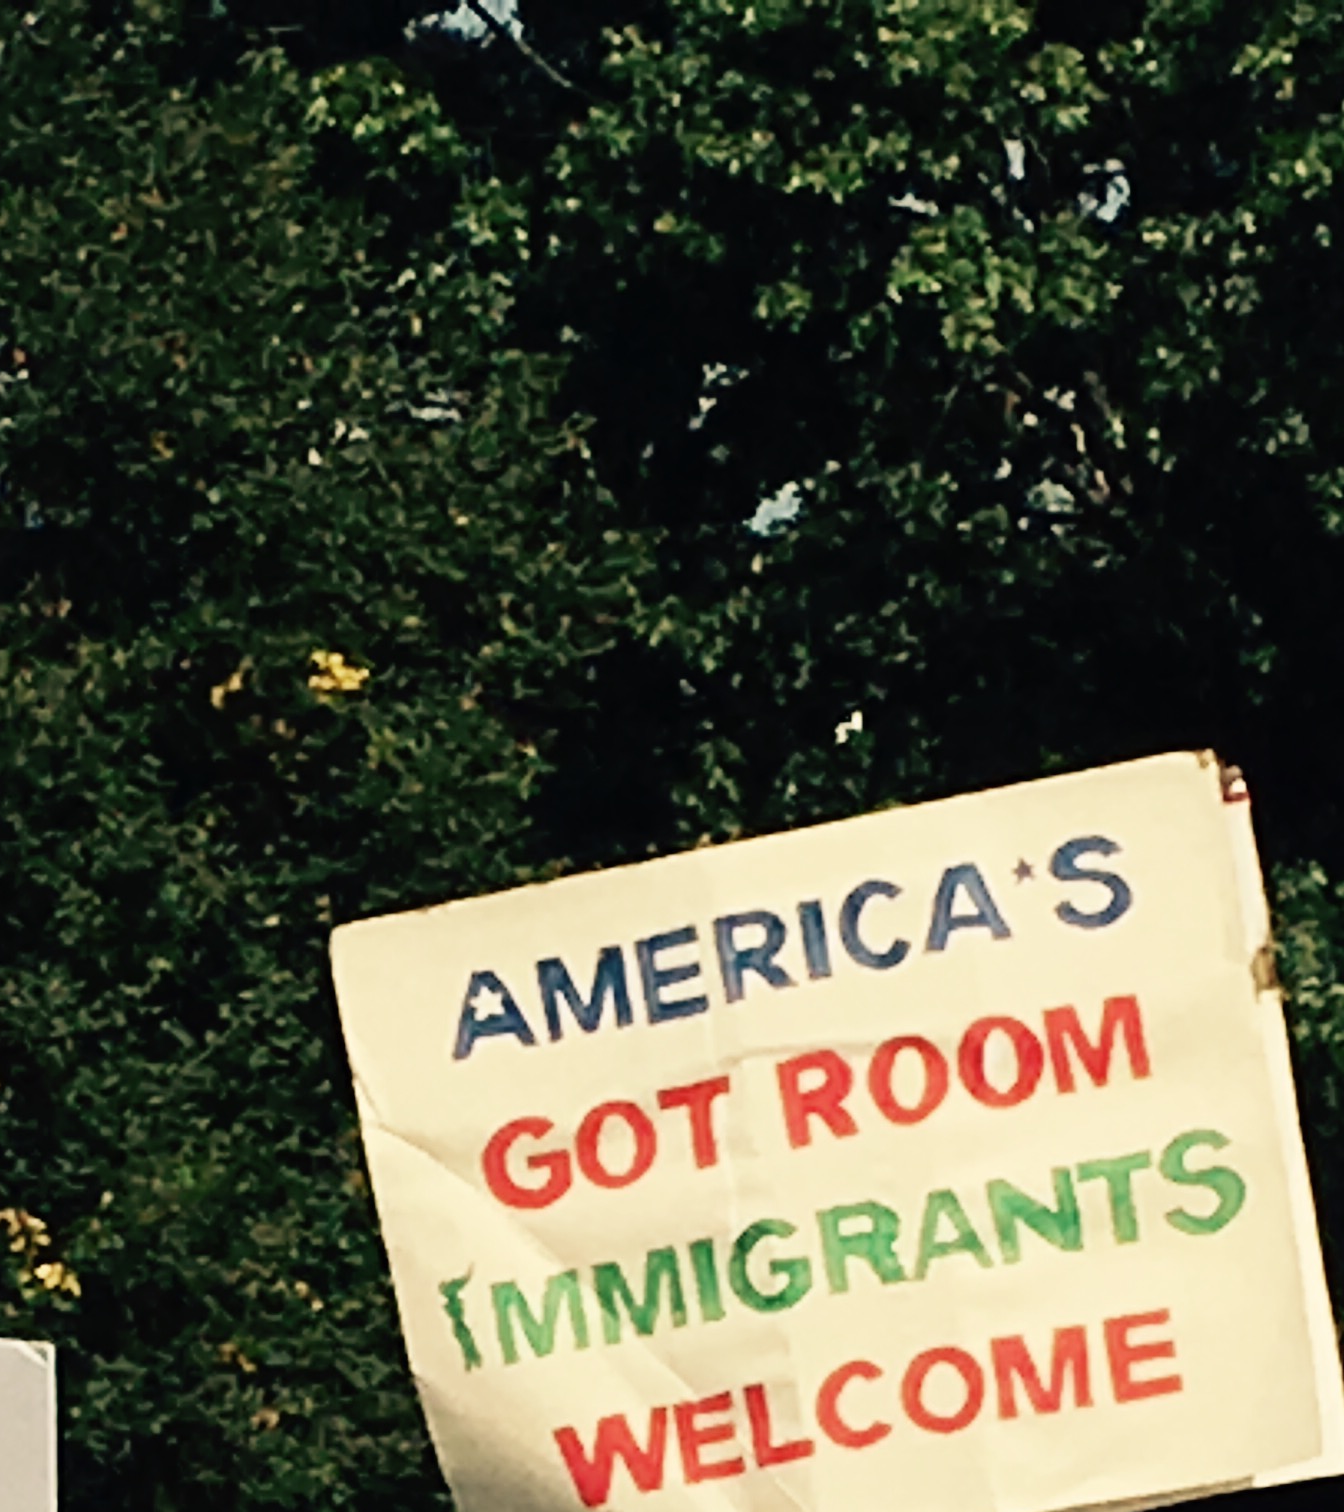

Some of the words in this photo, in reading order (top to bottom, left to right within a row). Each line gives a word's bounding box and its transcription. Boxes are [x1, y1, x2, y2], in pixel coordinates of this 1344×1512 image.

[479, 1076, 730, 1210] GOT
[775, 993, 1152, 1151] ROOM
[438, 1128, 1248, 1373] IMMIGRANTS
[553, 1308, 1184, 1510] WELCOME
